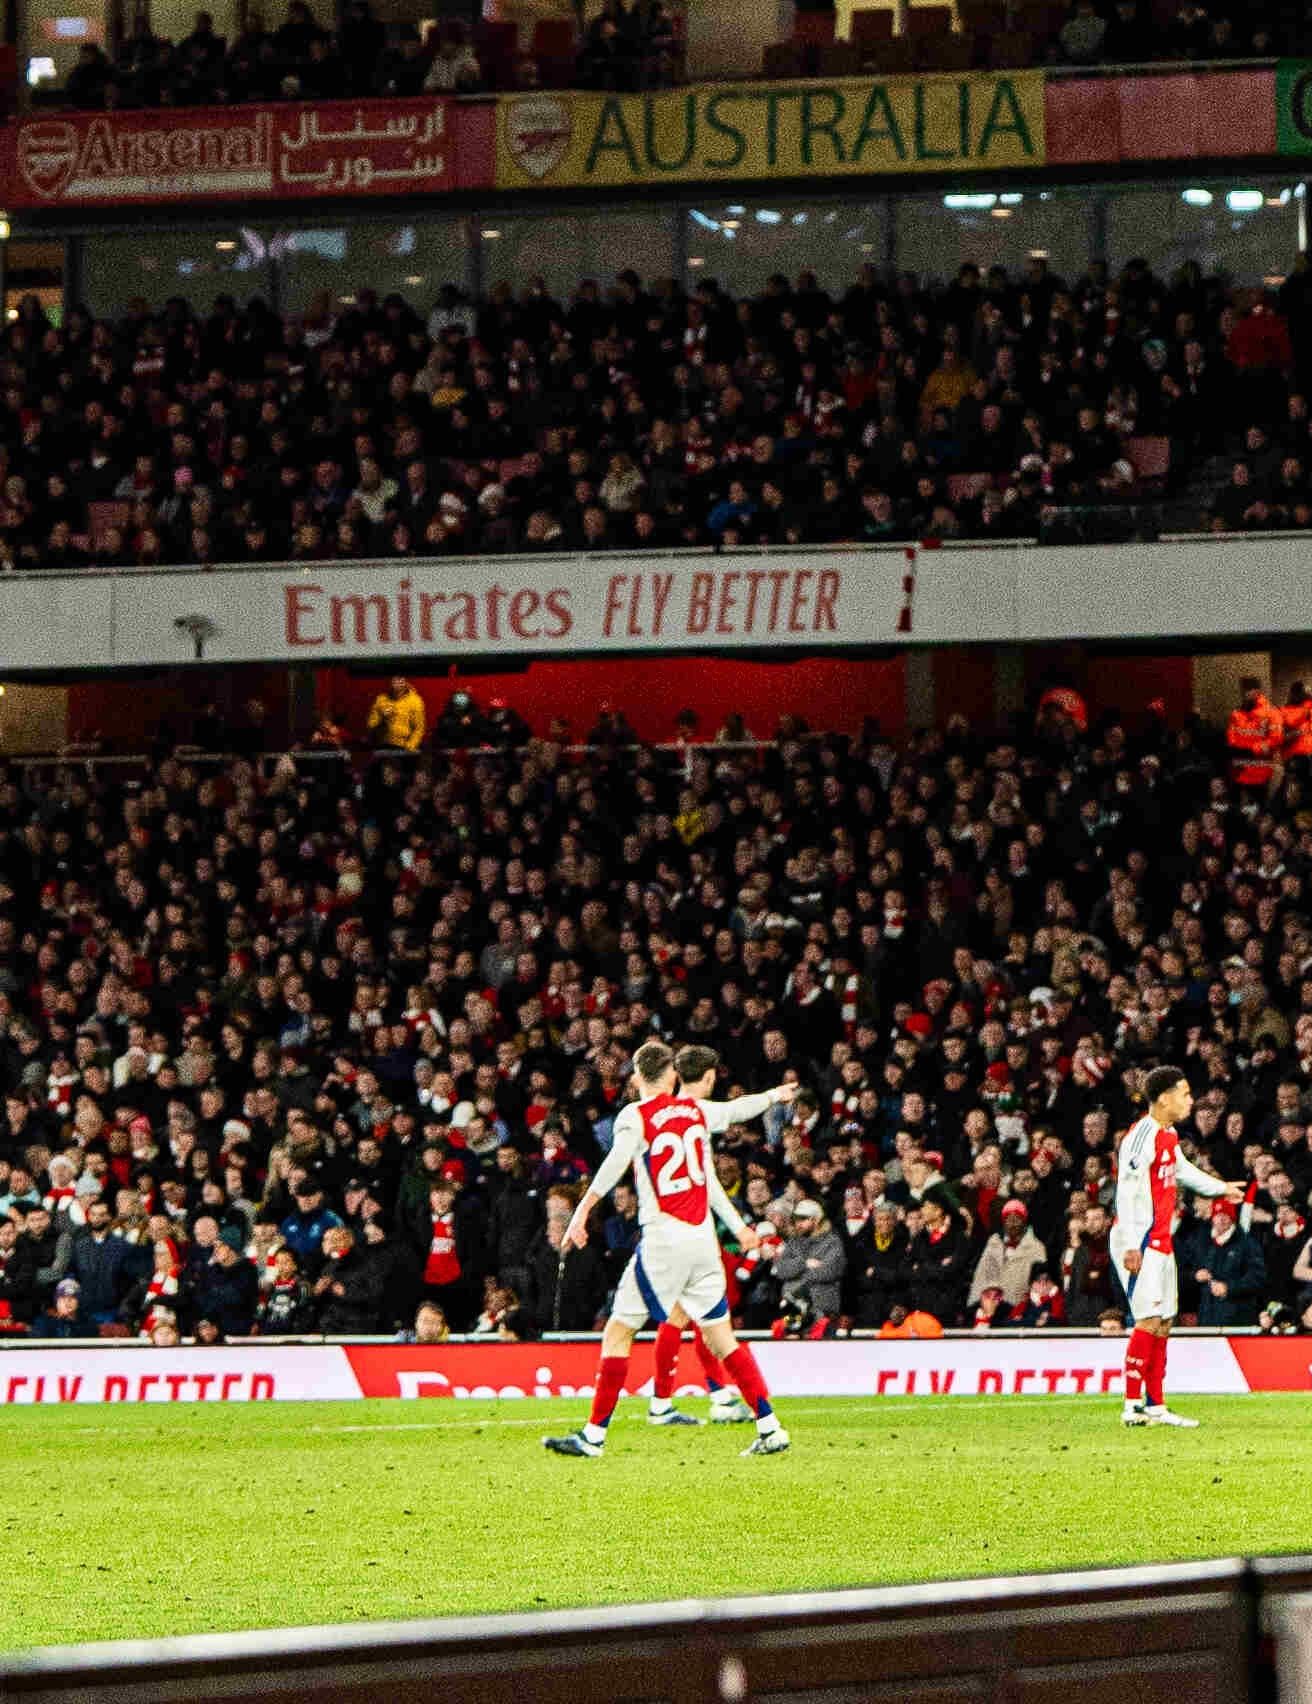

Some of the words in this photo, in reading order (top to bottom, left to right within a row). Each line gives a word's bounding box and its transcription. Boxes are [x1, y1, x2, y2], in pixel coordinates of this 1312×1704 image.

[75, 111, 273, 177] Arsenal
[585, 78, 1036, 173] AUSTRALIA
[283, 578, 573, 647] Emirates
[601, 571, 674, 638] FLY
[686, 567, 841, 635] BETTER
[650, 1123, 706, 1197] 20
